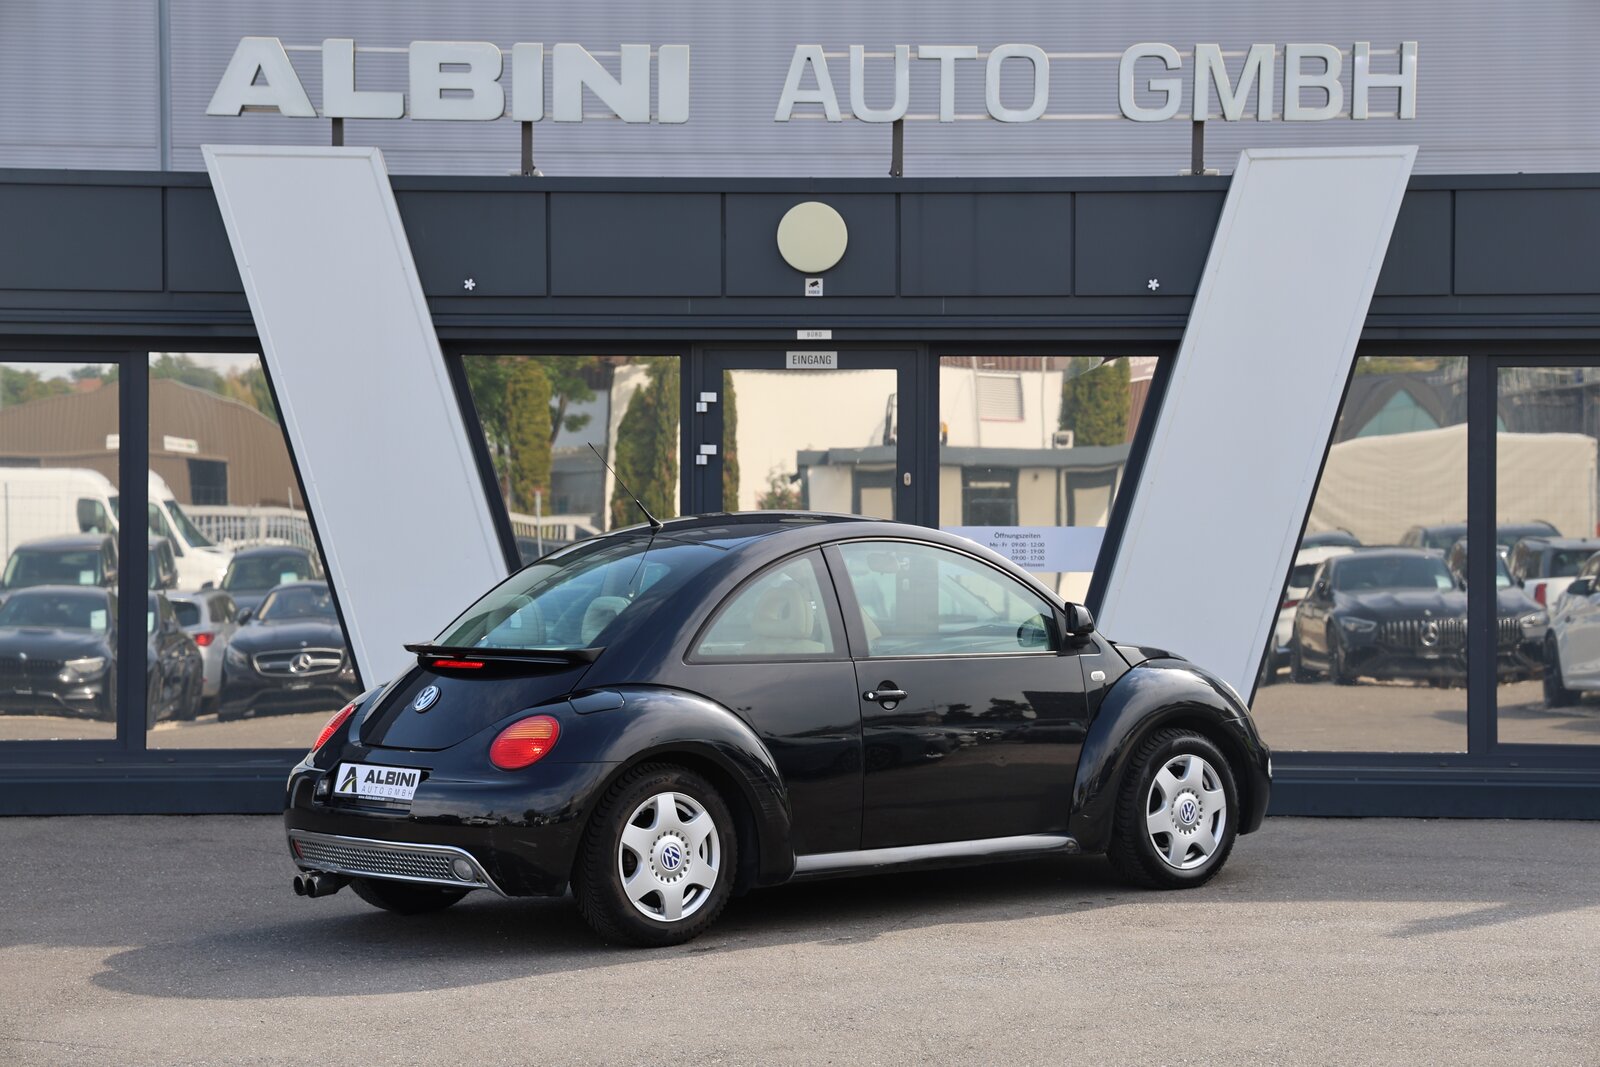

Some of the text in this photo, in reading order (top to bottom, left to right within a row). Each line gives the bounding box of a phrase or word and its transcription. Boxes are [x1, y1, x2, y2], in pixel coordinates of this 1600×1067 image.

[206, 36, 1418, 123] ALBINI AUTO GMBH
[792, 355, 832, 365] EINGANG
[364, 769, 416, 787] ALBINI
[361, 785, 413, 797] AUTO GMBH
